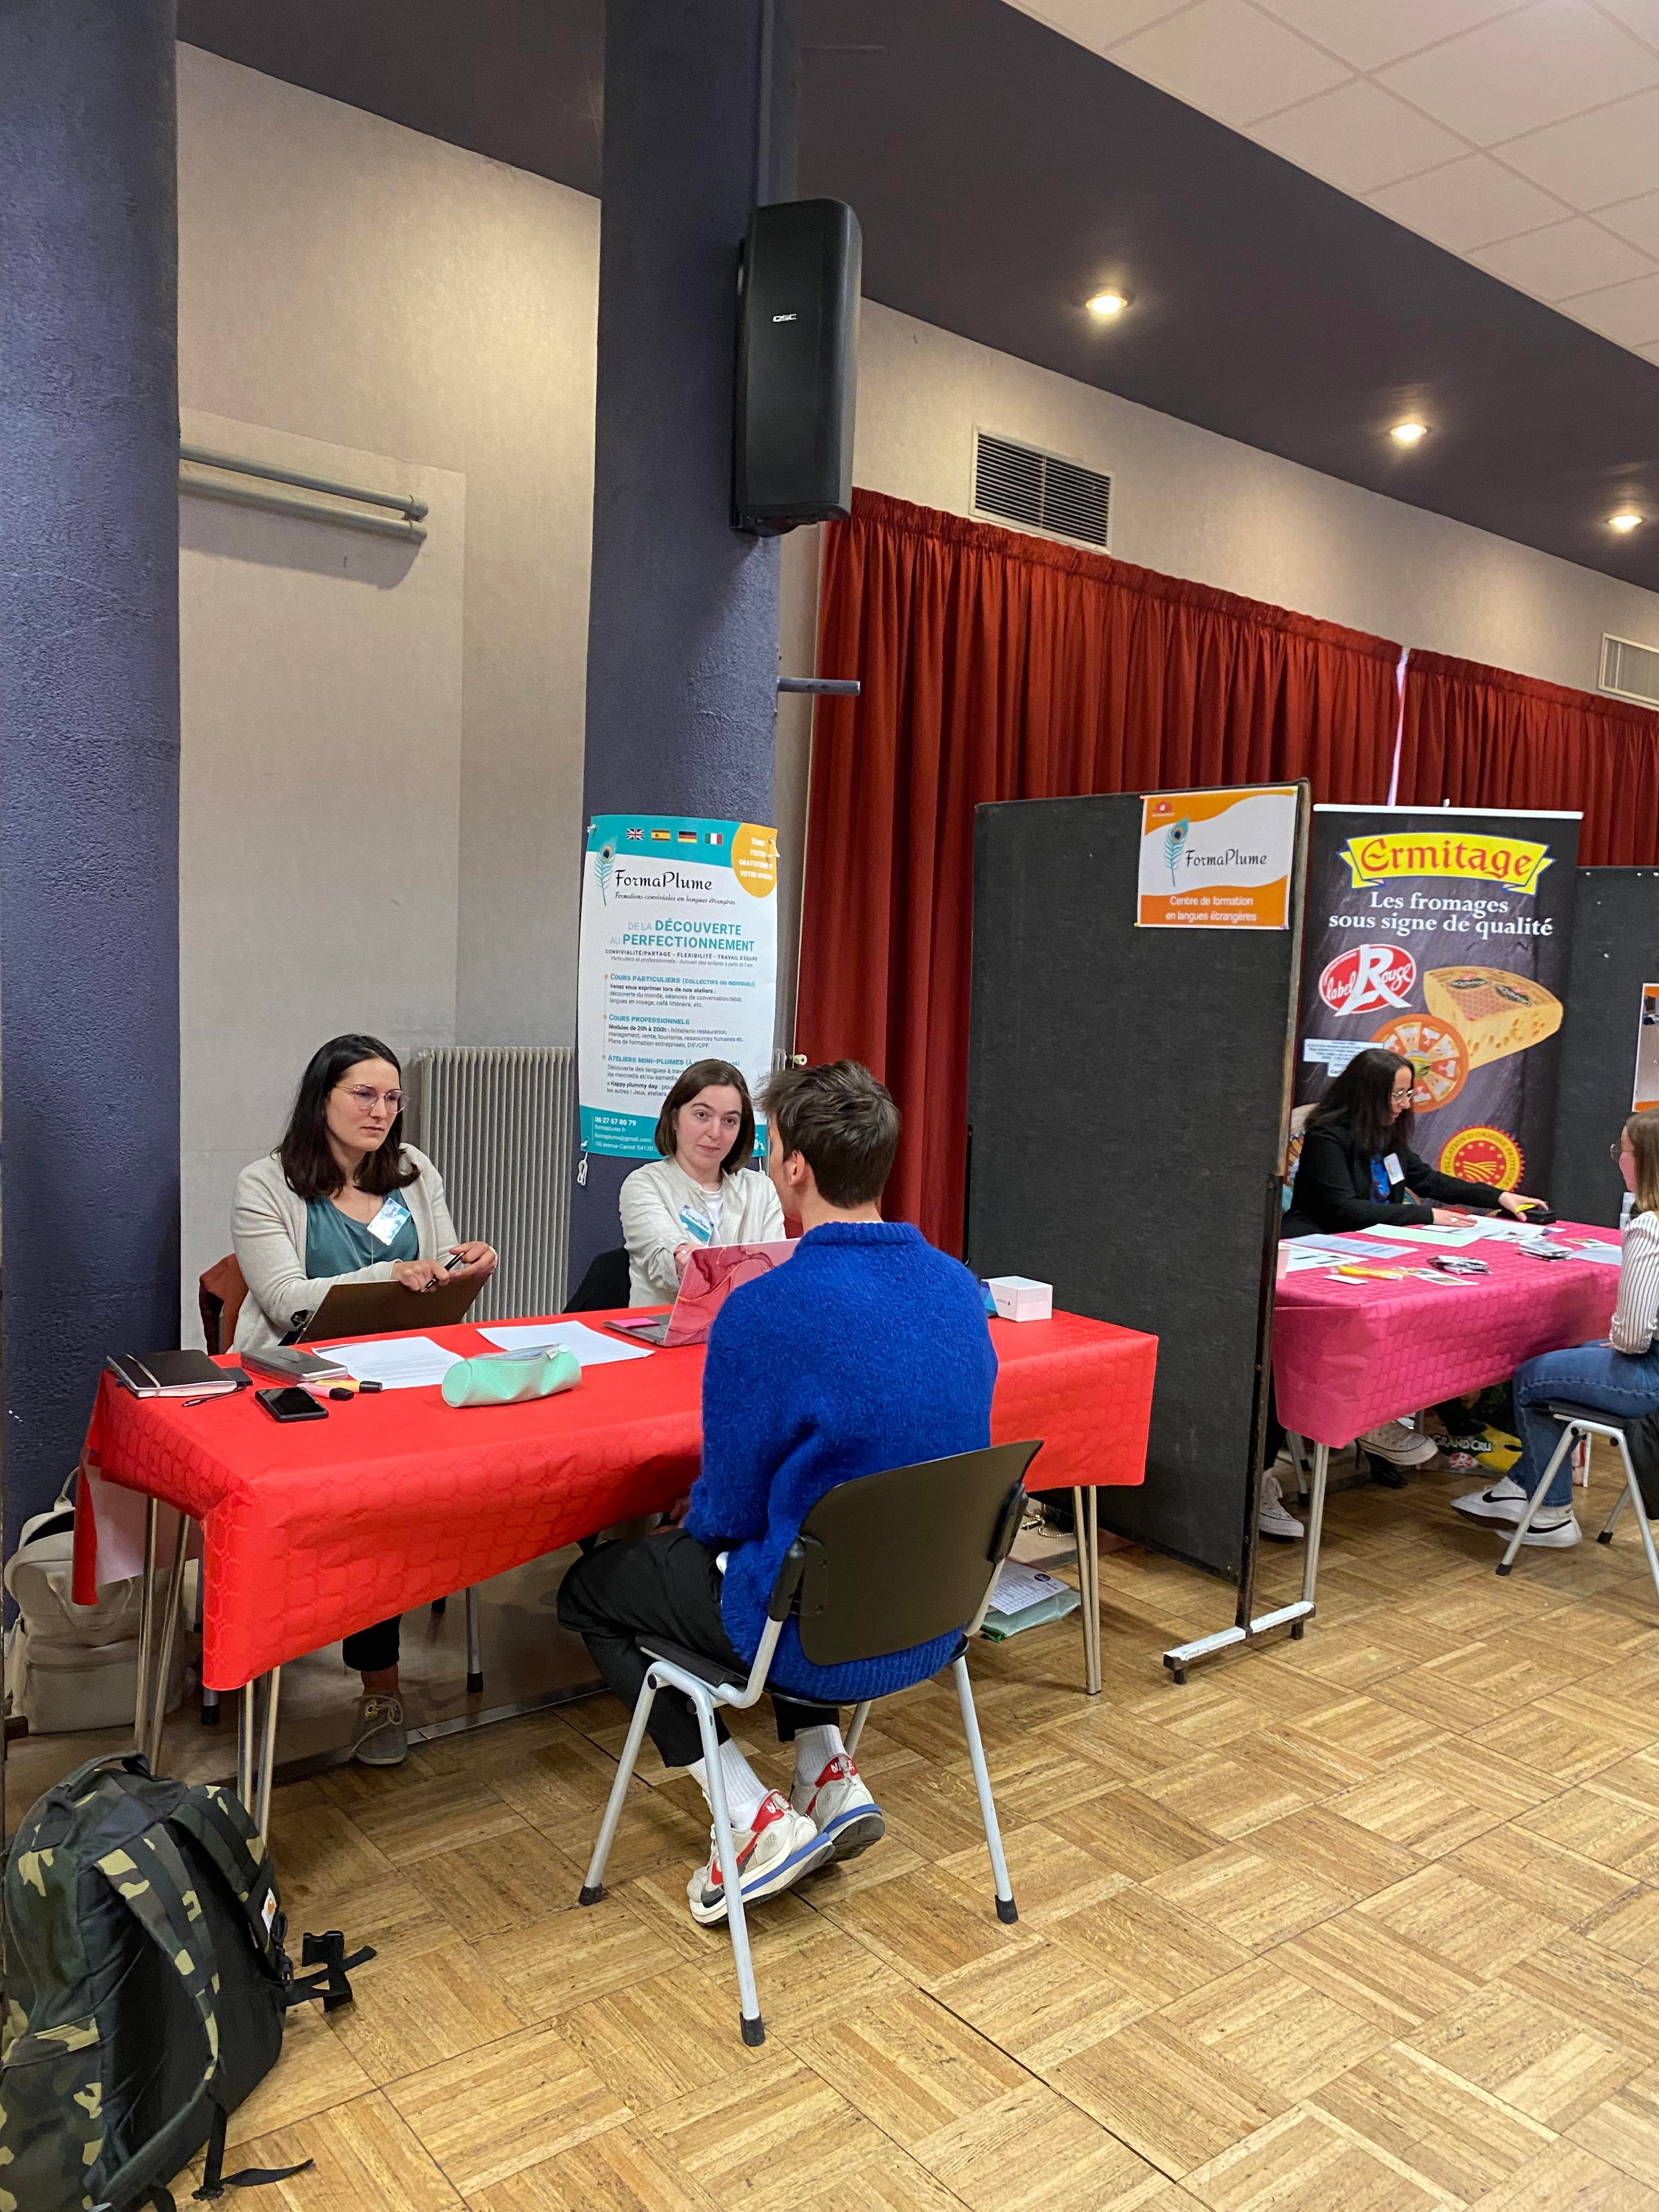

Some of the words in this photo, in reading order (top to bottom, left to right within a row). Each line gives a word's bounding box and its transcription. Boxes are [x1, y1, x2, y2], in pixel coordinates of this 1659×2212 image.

[773, 314, 797, 322] QSC
[1186, 849, 1268, 868] FormaPlume
[1361, 838, 1532, 879] Ermitage
[614, 869, 713, 890] FormaPlume
[615, 891, 643, 900] Formations
[686, 895, 708, 904] langues
[1170, 896, 1198, 905] Centre
[1200, 896, 1210, 905] de
[1213, 895, 1253, 905] formation
[1370, 891, 1404, 909] Les
[1410, 892, 1509, 918] fromages
[1165, 912, 1176, 921] en
[1177, 911, 1208, 923] langues
[1210, 911, 1257, 924] étrangères
[628, 922, 639, 930] DE
[641, 922, 652, 931] LA
[655, 918, 742, 935] DÉCOUVERTE
[1329, 914, 1376, 928] sous
[1381, 913, 1438, 936] signe
[1442, 915, 1470, 932] de
[1475, 917, 1554, 940] qualité
[610, 936, 620, 945] AU
[623, 934, 755, 952] PERFECTIONNEMENT
[631, 1016, 690, 1025] PROFESSIONNELS
[638, 1057, 684, 1065] MINI-PLUMES
[830, 1760, 855, 1774] NIE
